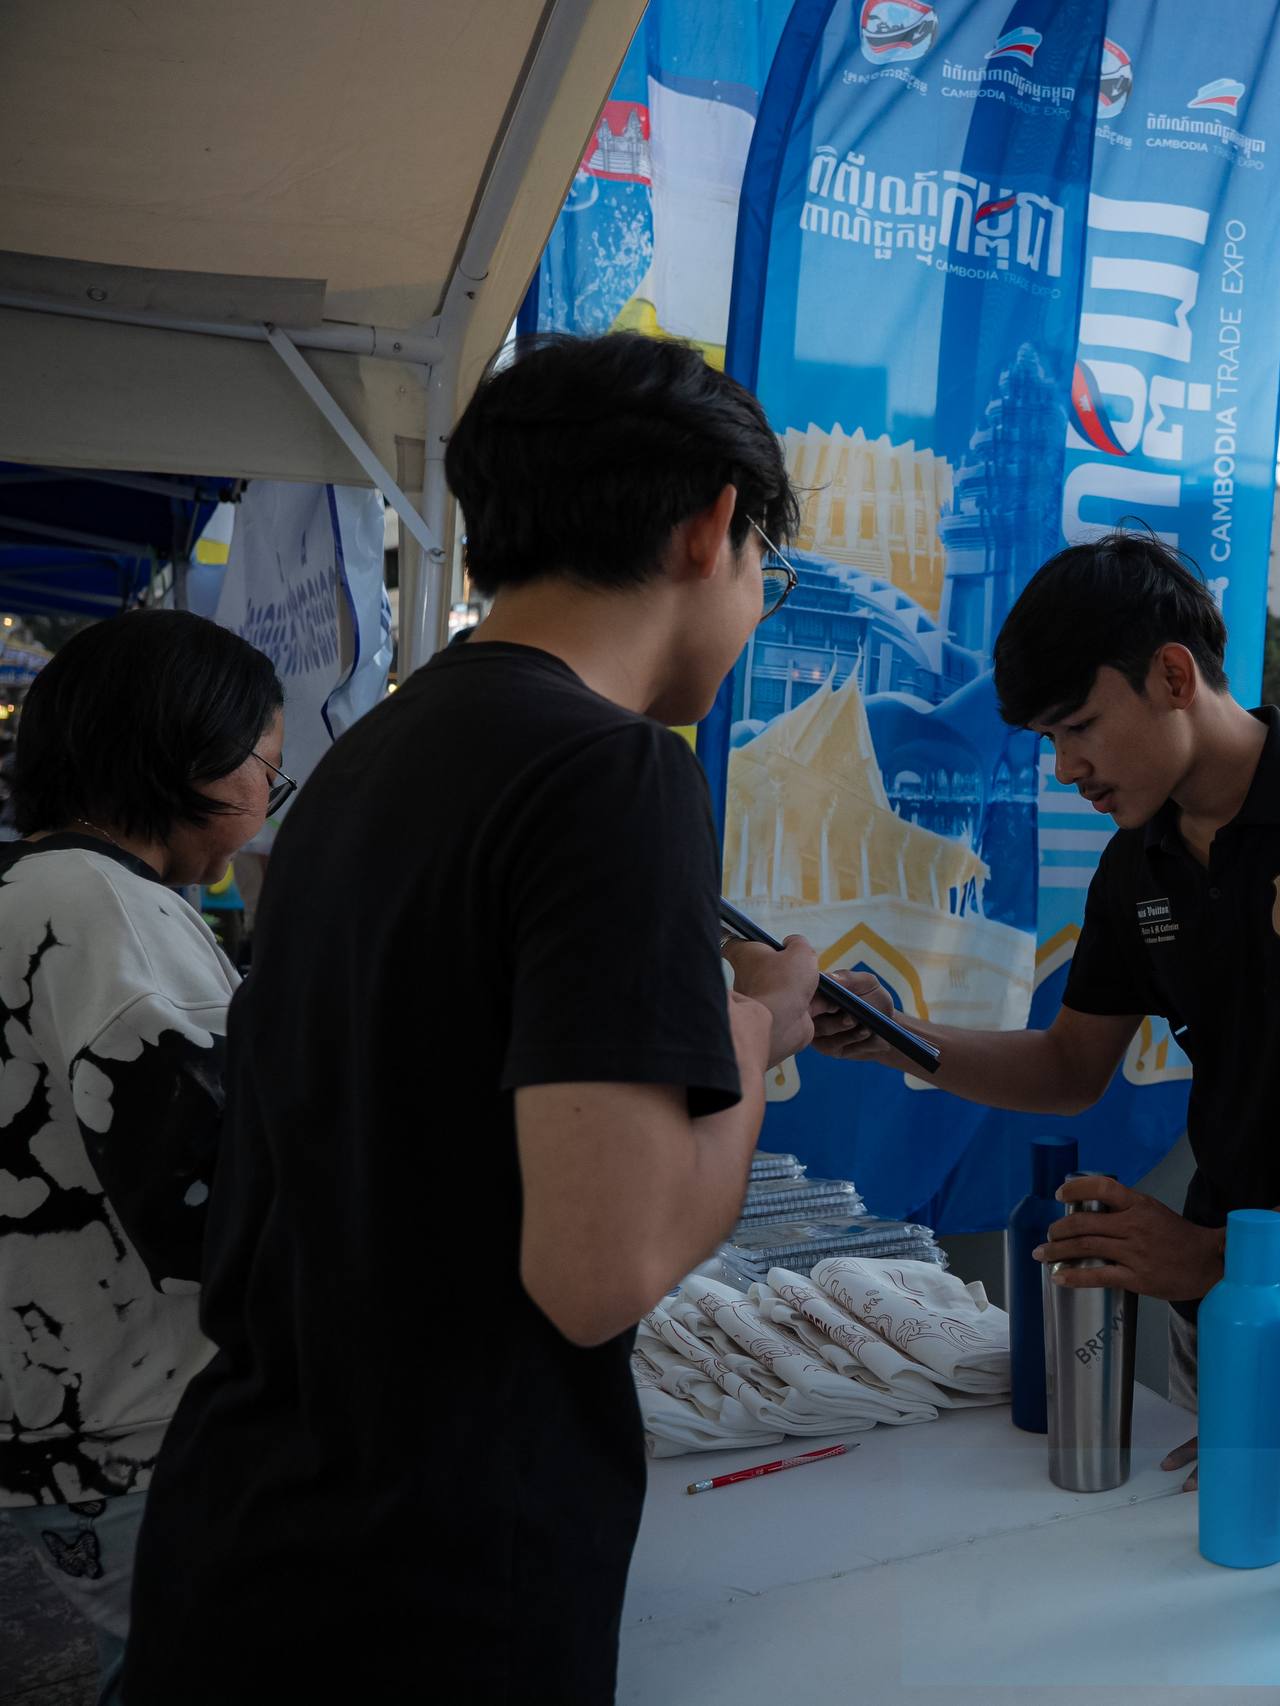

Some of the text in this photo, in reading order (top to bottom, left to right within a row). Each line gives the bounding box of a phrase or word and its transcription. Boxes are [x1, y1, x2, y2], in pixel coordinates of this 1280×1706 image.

[941, 86, 1006, 103] CAMBODIA
[1146, 137, 1209, 153] CAMBODIA
[935, 258, 1000, 282] CAMBODIA
[1221, 219, 1247, 295] EXPO
[1216, 307, 1242, 399] TRADE
[1210, 405, 1238, 563] CAMBODIA
